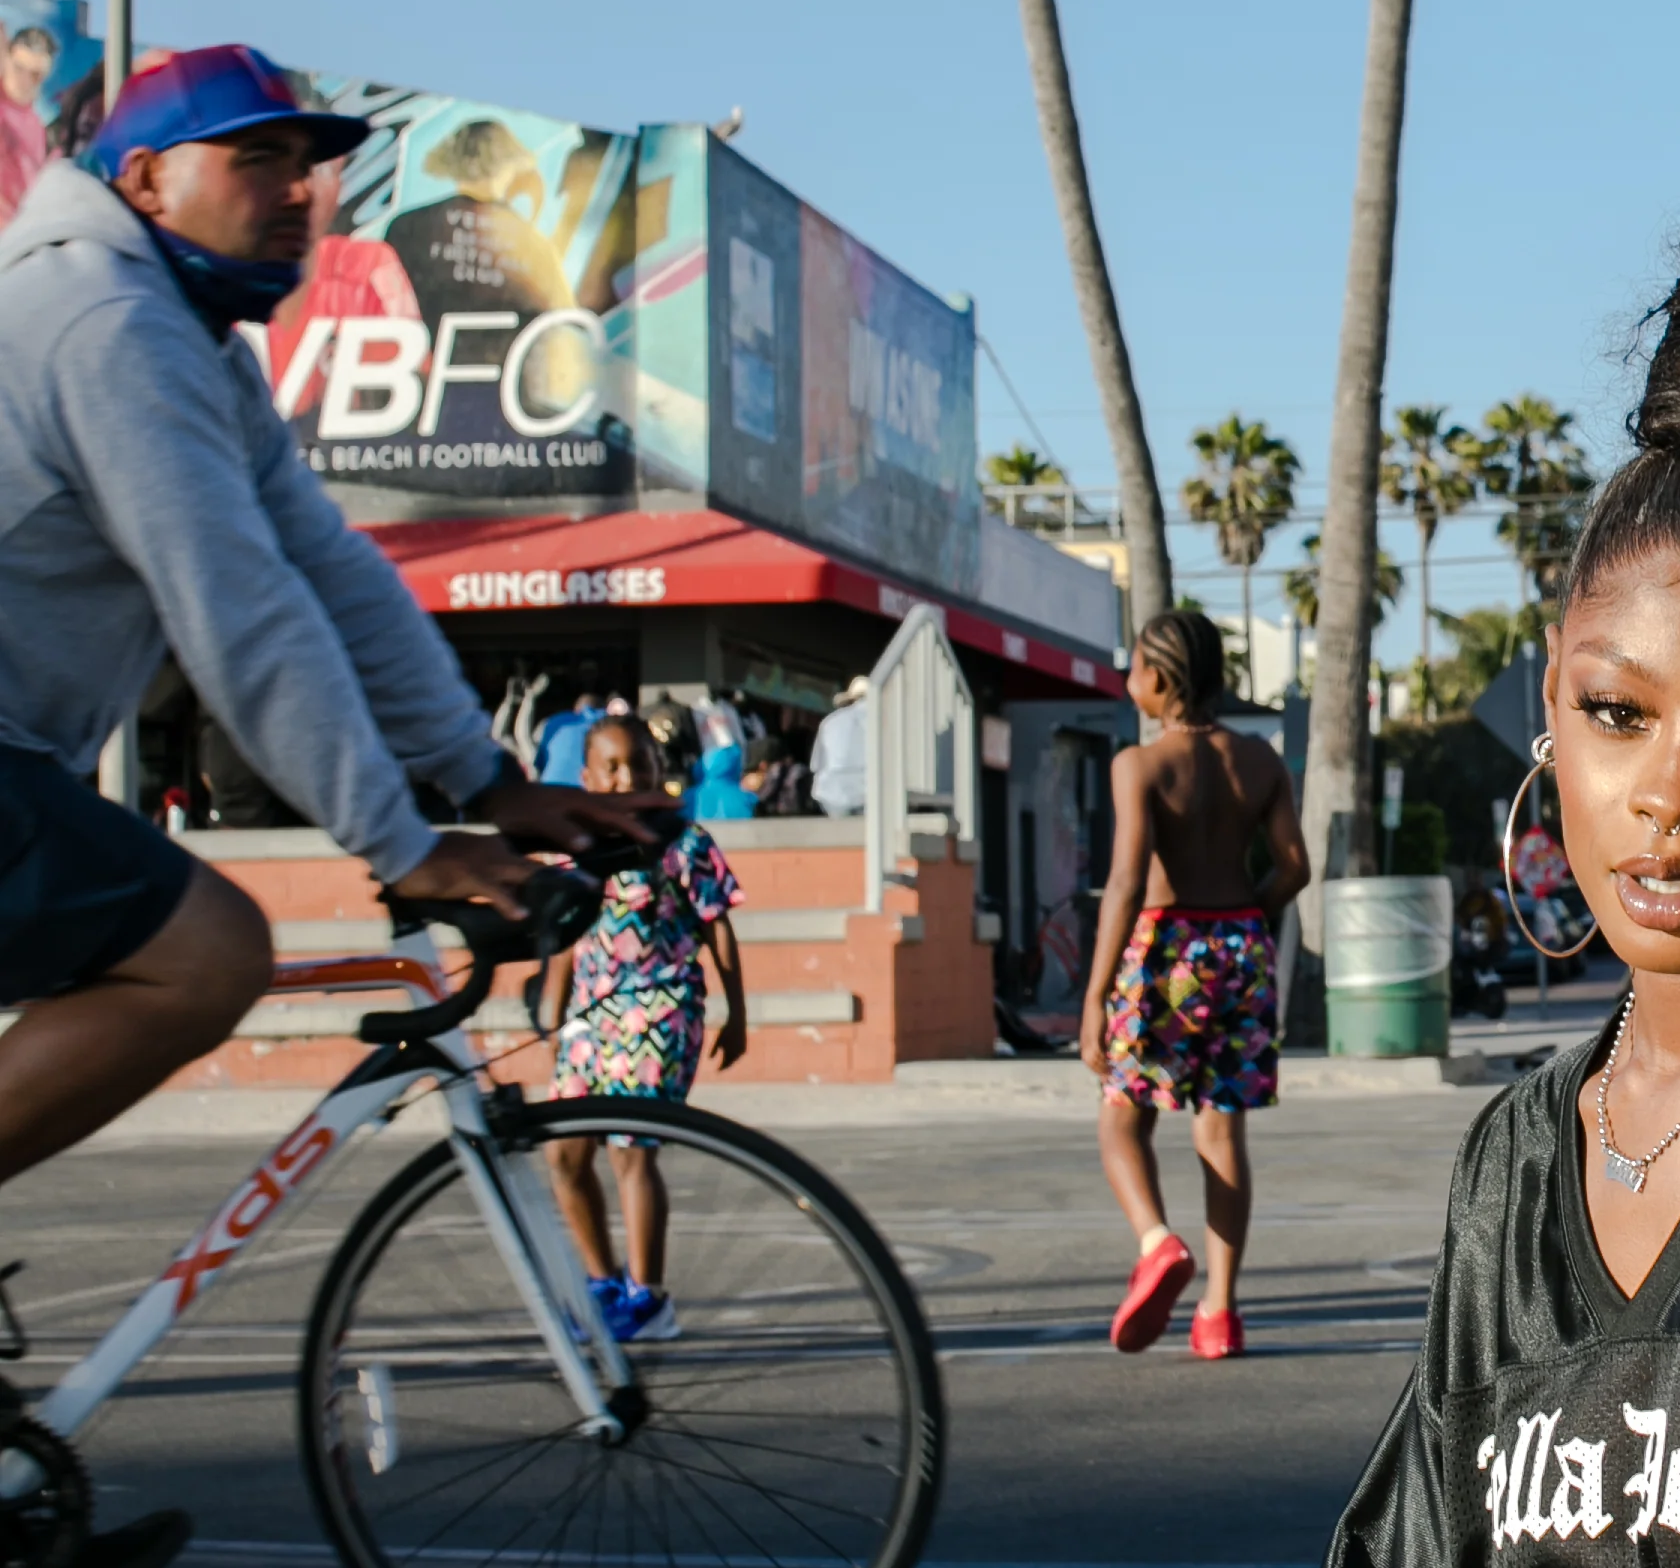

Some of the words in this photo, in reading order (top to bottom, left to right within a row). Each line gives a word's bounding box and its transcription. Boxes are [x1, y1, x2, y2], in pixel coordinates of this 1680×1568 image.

[234, 308, 606, 440] VBFC
[331, 444, 413, 471] BEACH
[418, 442, 541, 469] FOOTBALL
[546, 440, 607, 468] CLUB
[450, 566, 667, 609] SUNGLASSES
